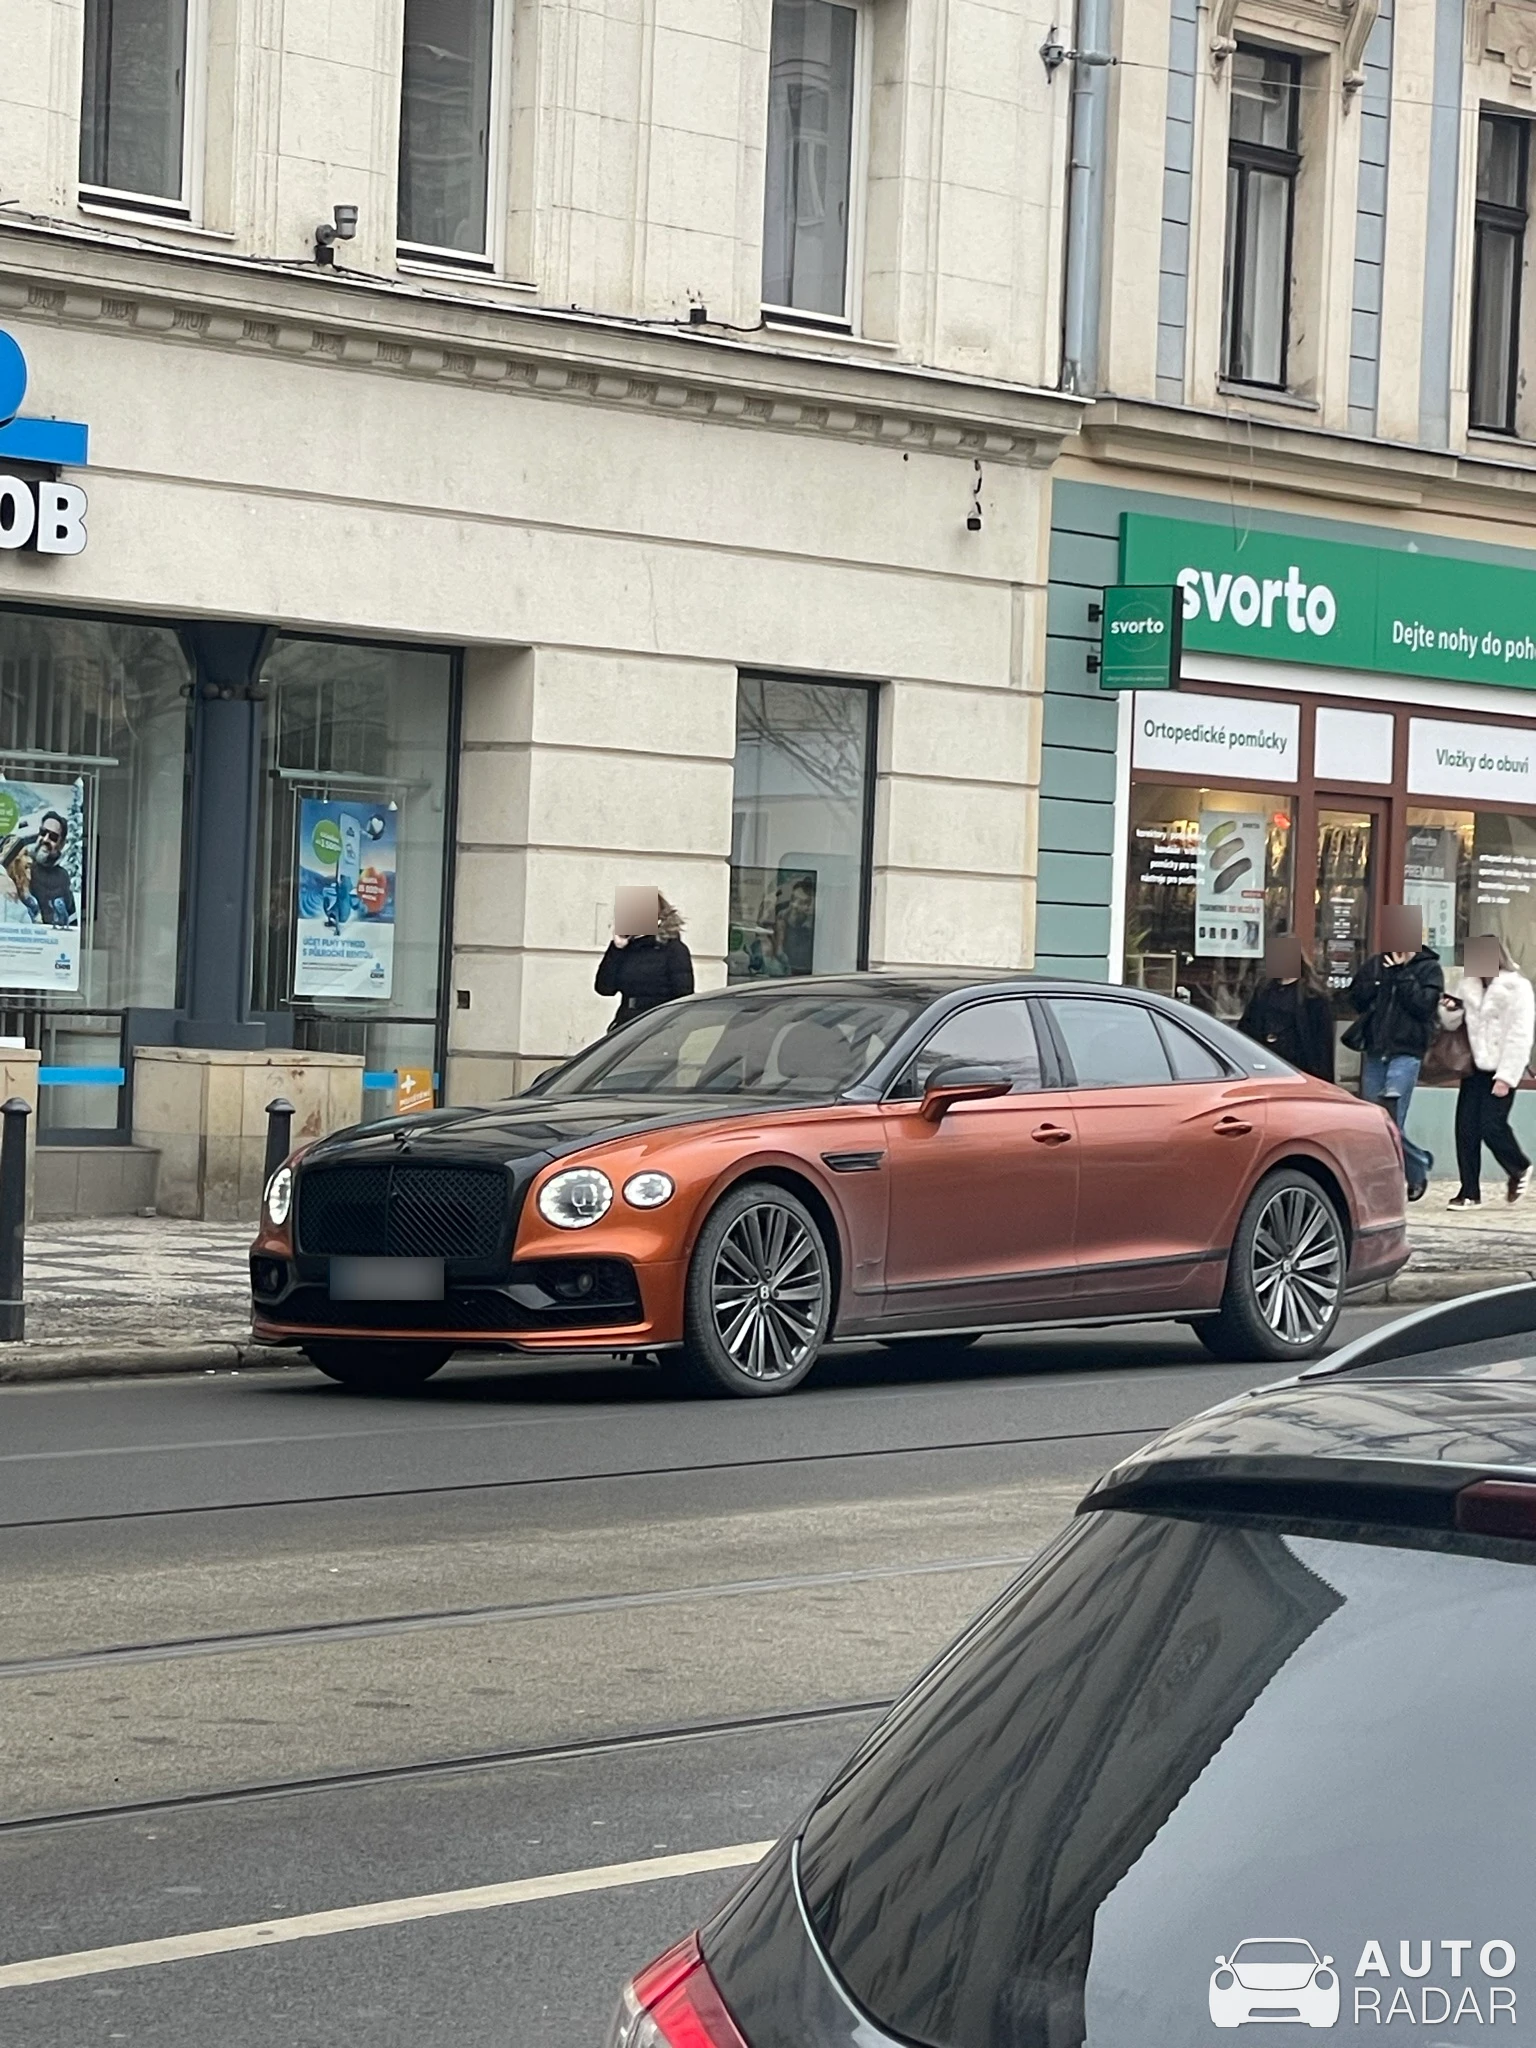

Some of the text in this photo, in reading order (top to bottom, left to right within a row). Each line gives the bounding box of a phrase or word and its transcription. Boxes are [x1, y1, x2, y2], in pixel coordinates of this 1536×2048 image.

[1176, 566, 1337, 636] svorto
[1111, 617, 1165, 634] svorto
[1393, 620, 1536, 663] Dejte nohy do poh
[1144, 719, 1288, 755] Ortopedické pomůcky
[1436, 749, 1530, 774] Vložky do obuví
